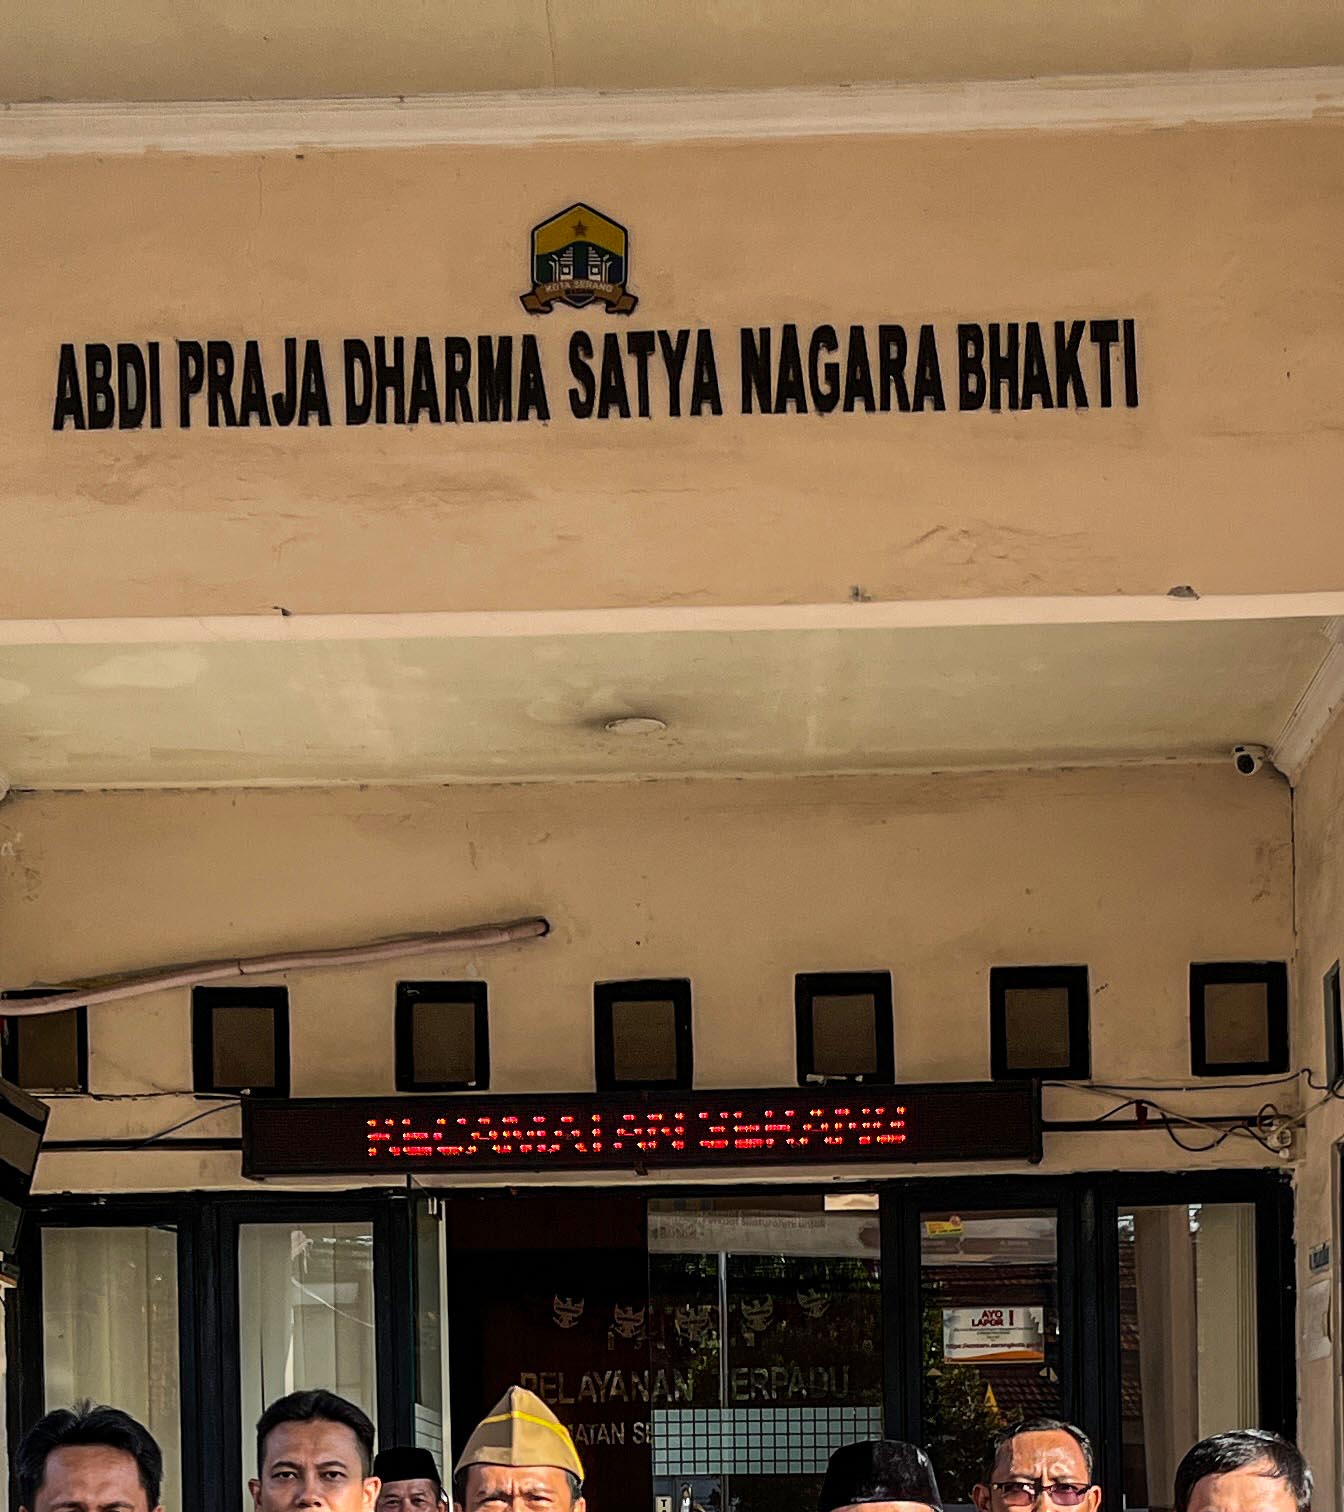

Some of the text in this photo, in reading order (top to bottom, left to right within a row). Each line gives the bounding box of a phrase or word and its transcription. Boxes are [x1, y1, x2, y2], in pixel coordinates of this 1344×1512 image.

[53, 318, 1139, 430] ABDI PRAJA DHARMA SATYA NAGARA BHAKTI
[972, 1319, 1004, 1327] LAPOR
[981, 1310, 1003, 1319] AYO
[712, 1364, 850, 1401] ERPADU
